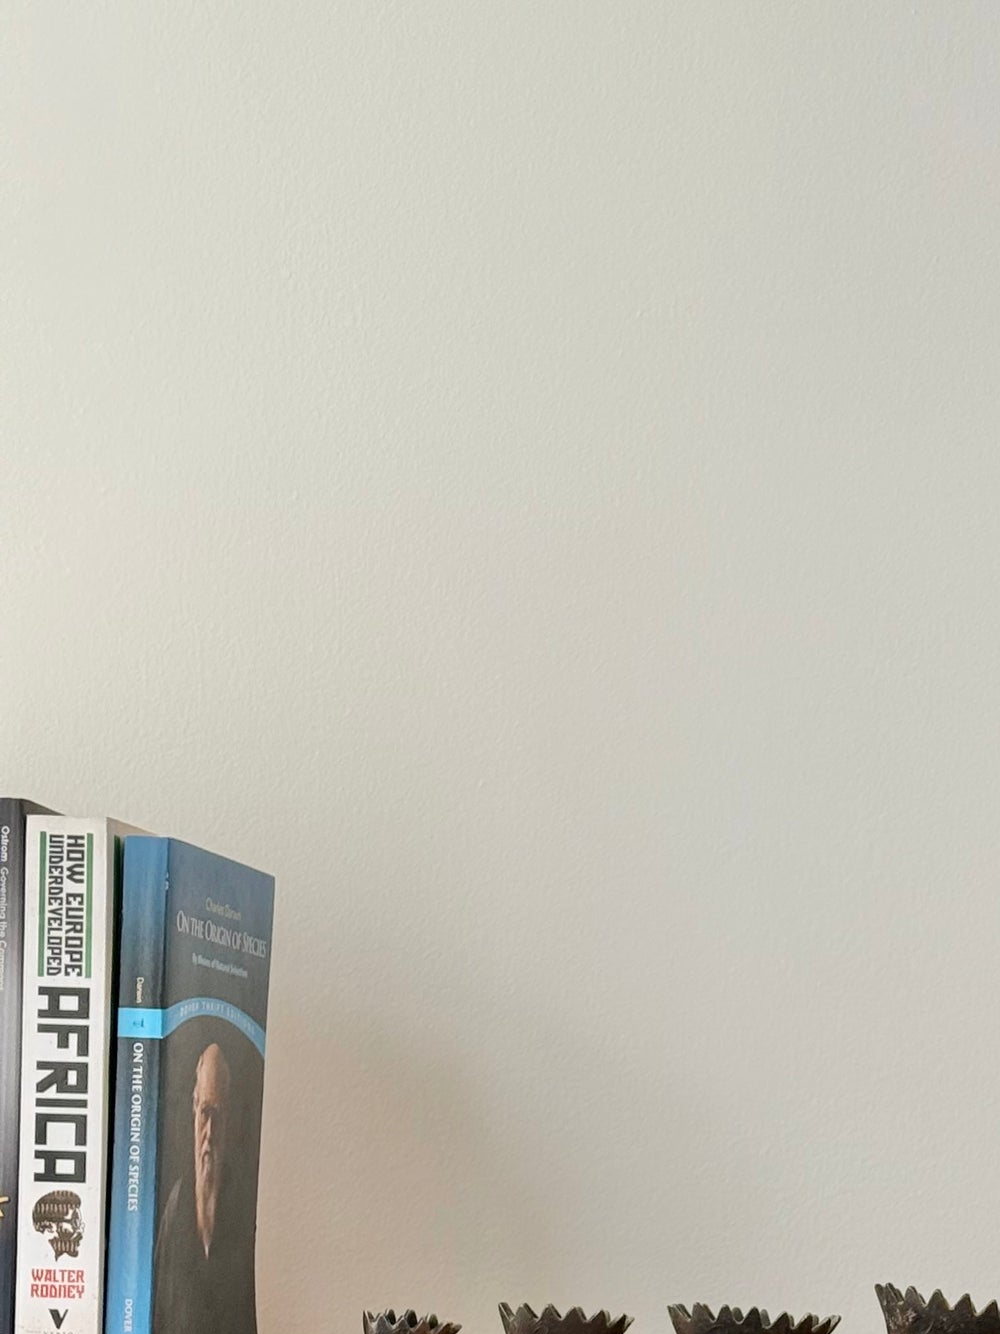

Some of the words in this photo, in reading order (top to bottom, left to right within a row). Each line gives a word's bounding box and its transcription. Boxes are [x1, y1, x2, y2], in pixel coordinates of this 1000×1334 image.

[1, 825, 10, 862] Ostrom
[66, 834, 85, 884] HOW
[47, 834, 64, 976] UNDERDEVELOPED
[64, 893, 85, 977] EUROPE
[177, 910, 190, 934] ON
[191, 917, 204, 939] THE
[205, 919, 232, 947] ORIGIN
[232, 931, 242, 950] OF
[243, 931, 267, 958] SPECIES
[132, 1042, 144, 1063] ON
[34, 986, 90, 1183] AFRICA
[131, 1065, 143, 1092] THE
[130, 1094, 142, 1142] ORIGIN
[129, 1145, 140, 1163] OF
[128, 1165, 140, 1211] SPECIES
[30, 1284, 85, 1299] RODNEY
[31, 1268, 85, 1283] WALTER
[124, 1299, 133, 1333] DOVER
